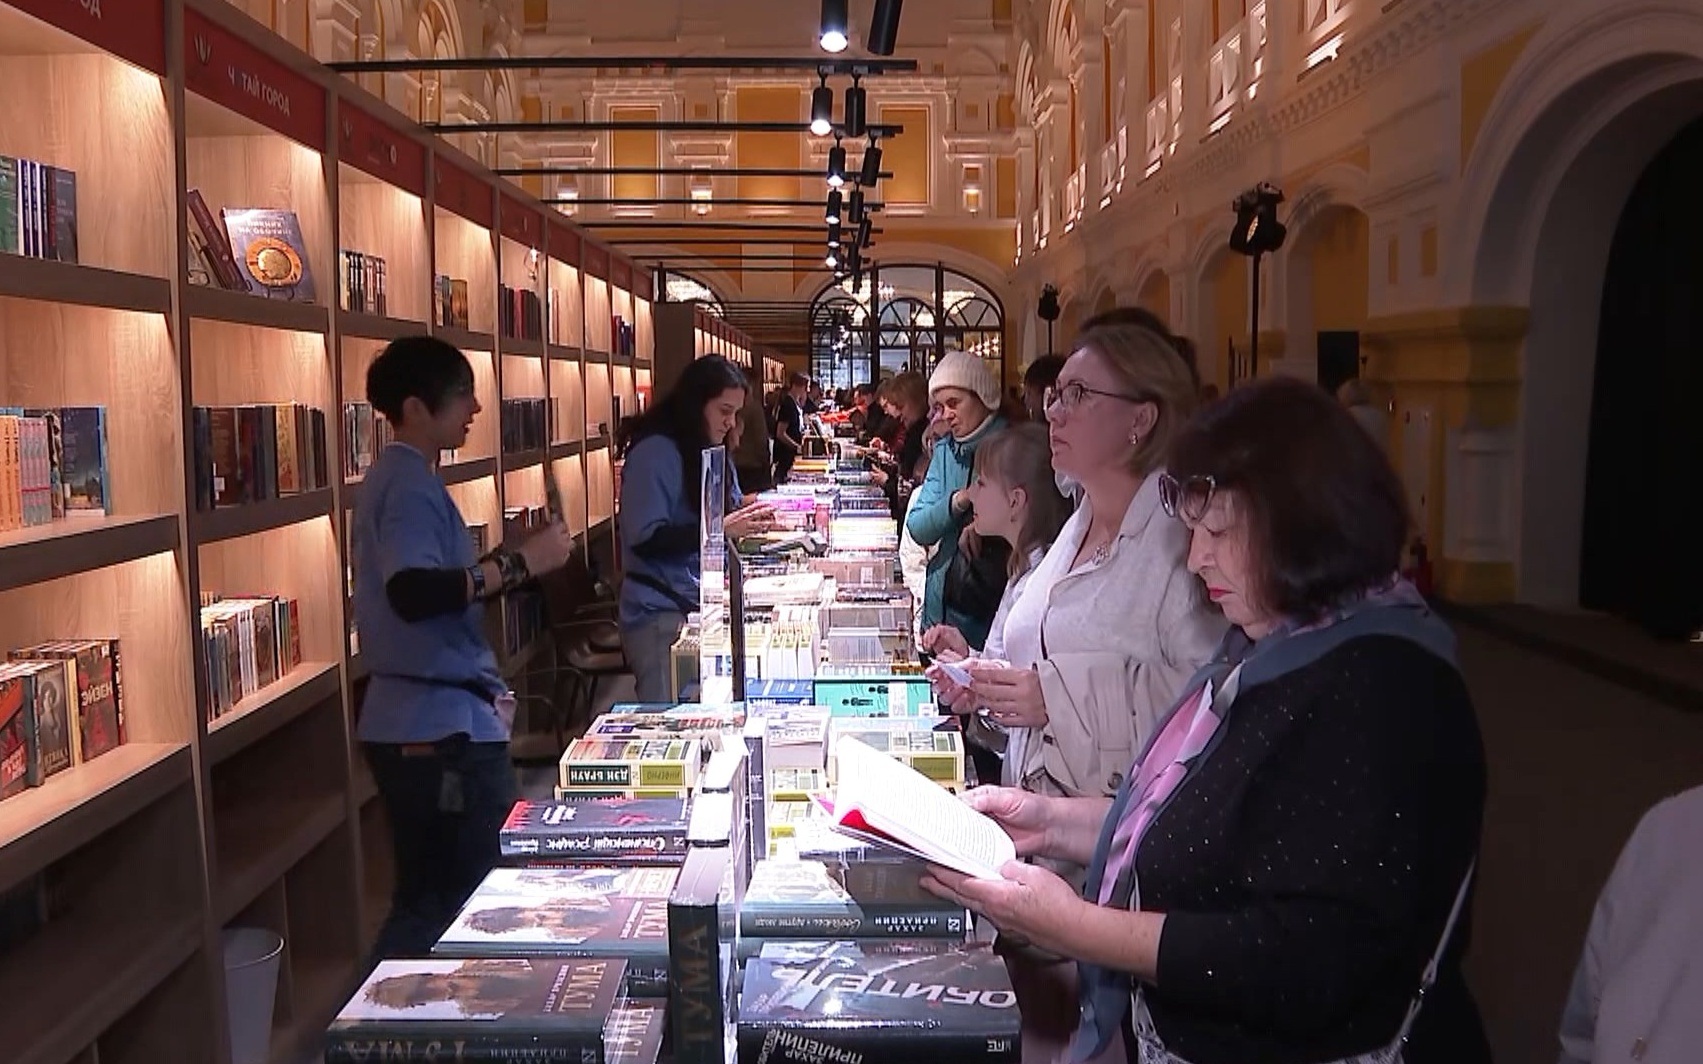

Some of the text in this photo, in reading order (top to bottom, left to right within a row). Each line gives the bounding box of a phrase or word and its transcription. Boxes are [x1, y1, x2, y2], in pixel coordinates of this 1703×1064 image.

[227, 64, 290, 117] ЧТАЙ ГОРОД
[81, 680, 113, 707] ЭЙЗЕН
[570, 769, 628, 781] ДЭН БРАУН
[874, 916, 937, 925] ПРИЛЕПИН
[887, 924, 924, 932] ЗАХАР
[558, 962, 607, 1013] ТУМА
[678, 924, 714, 1050] ТУМА
[771, 966, 1017, 1009] ОБИТЕЛЬ
[771, 1029, 863, 1064] ПРИЛЕПИН
